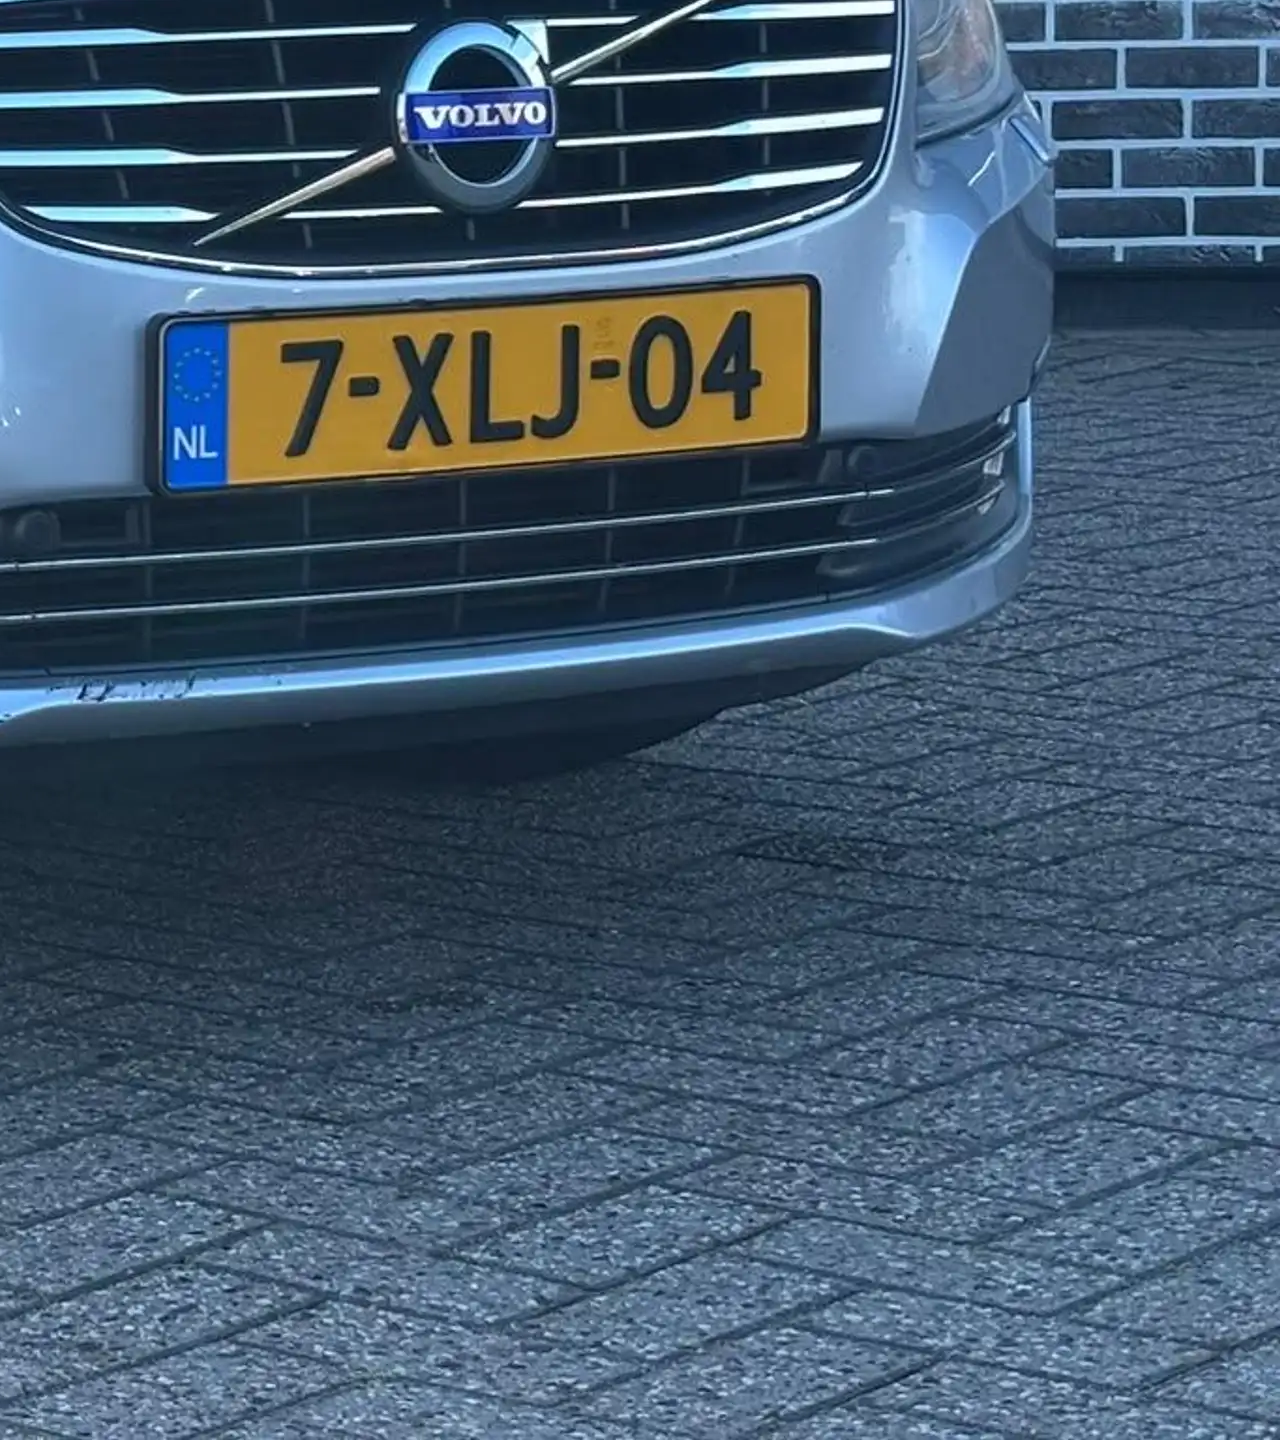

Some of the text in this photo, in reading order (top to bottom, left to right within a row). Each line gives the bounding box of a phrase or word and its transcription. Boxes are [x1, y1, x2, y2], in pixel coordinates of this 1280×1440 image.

[414, 101, 547, 129] VOLVO
[280, 310, 762, 458] 7-XLJ-04
[173, 424, 219, 461] NL
